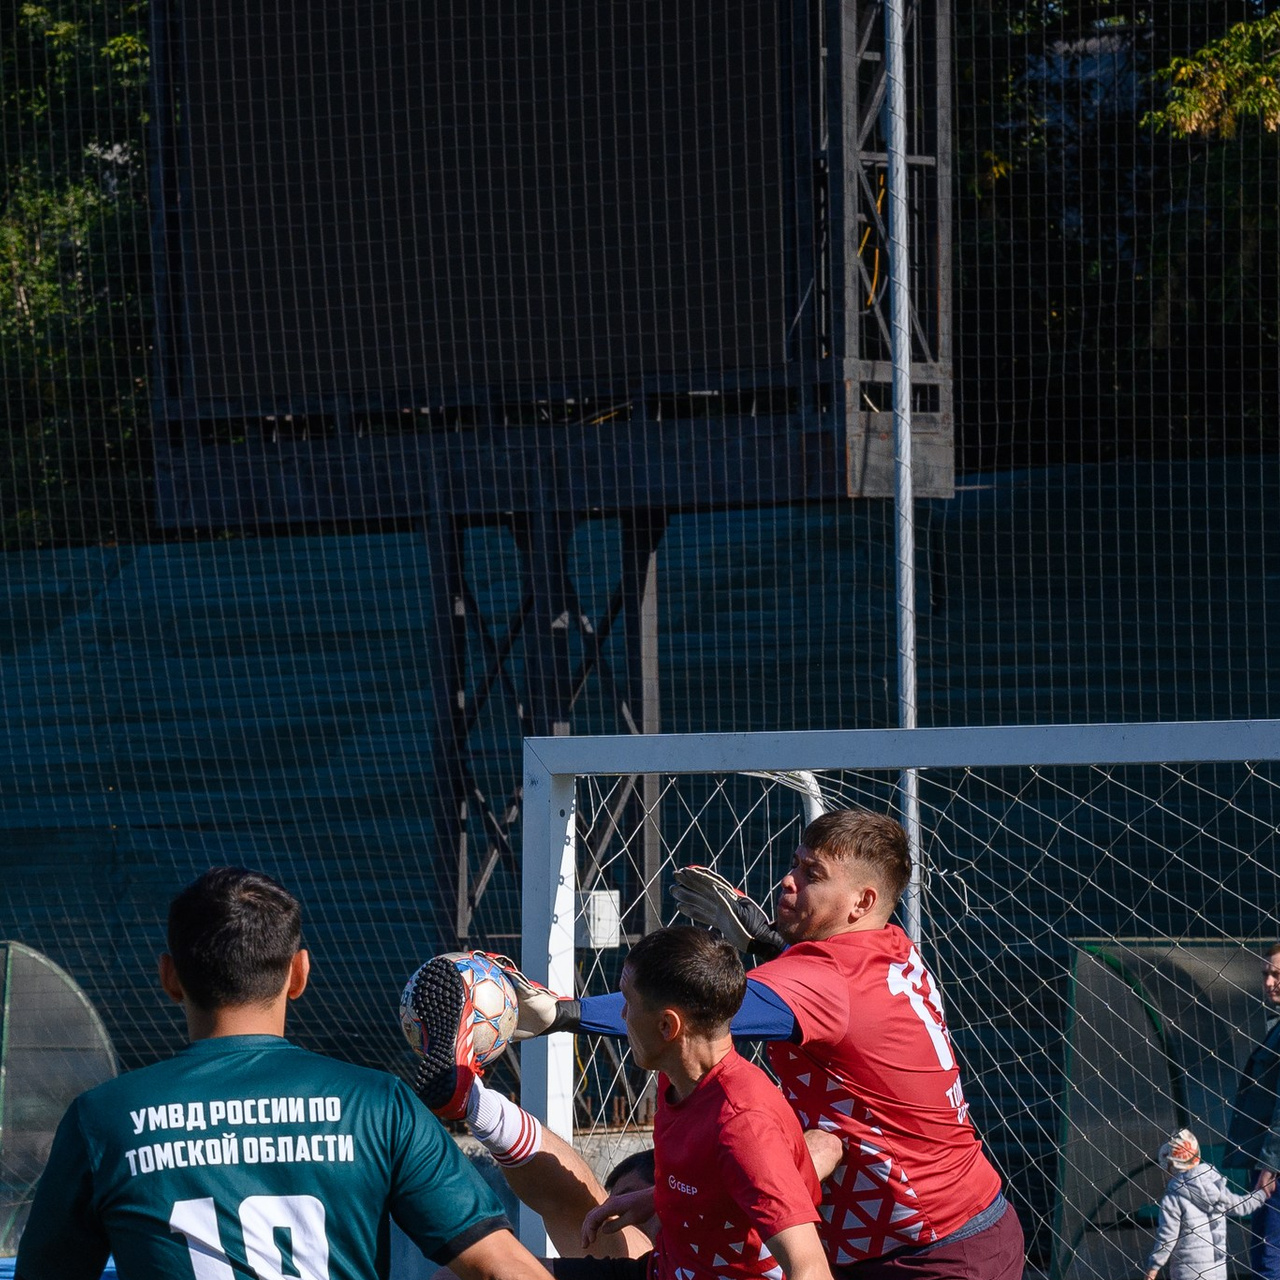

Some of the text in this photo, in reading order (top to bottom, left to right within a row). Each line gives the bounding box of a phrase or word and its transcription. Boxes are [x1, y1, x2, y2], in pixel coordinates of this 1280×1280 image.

[129, 1096, 342, 1135] УМВД РОССИИ ПО
[124, 1132, 354, 1177] ТОМСКОЙ ОБЛАСТИ
